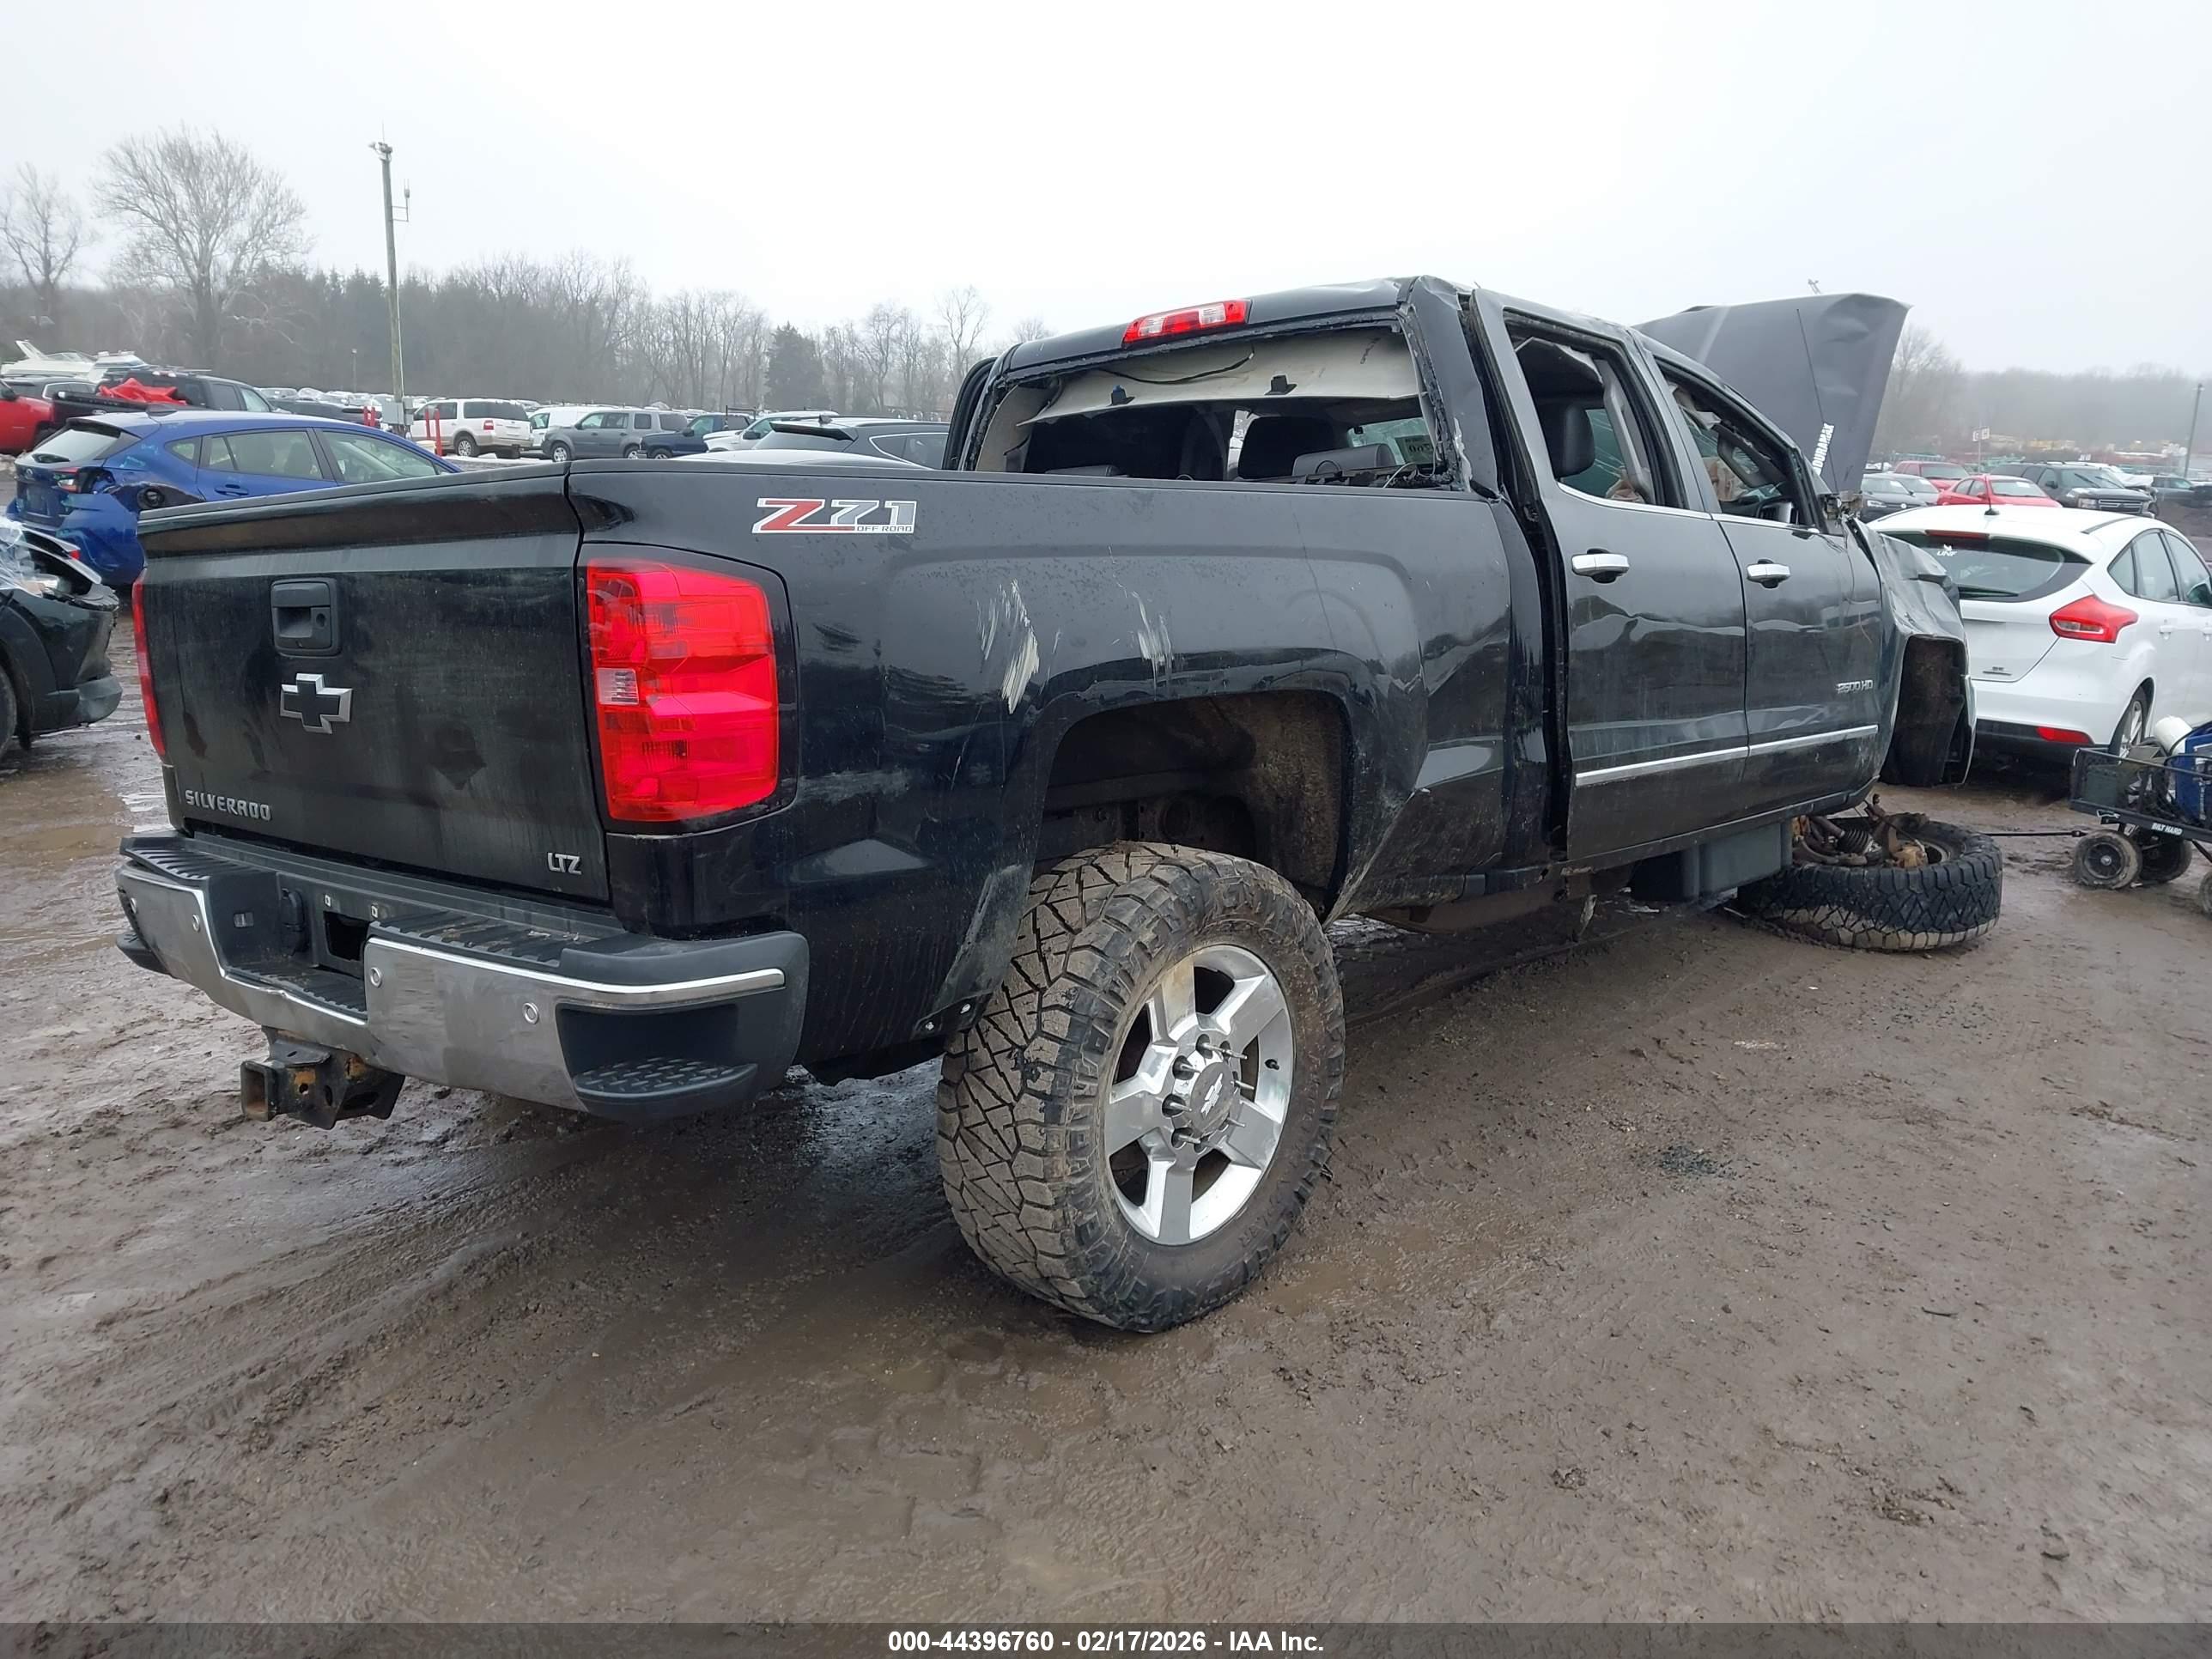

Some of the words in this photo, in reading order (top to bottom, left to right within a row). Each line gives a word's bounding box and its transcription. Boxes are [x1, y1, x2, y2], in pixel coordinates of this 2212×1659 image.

[1812, 422, 1835, 468] DURAMAX
[751, 497, 917, 533] Z71
[185, 788, 272, 822] SILVERADO
[547, 852, 582, 875] LTZ
